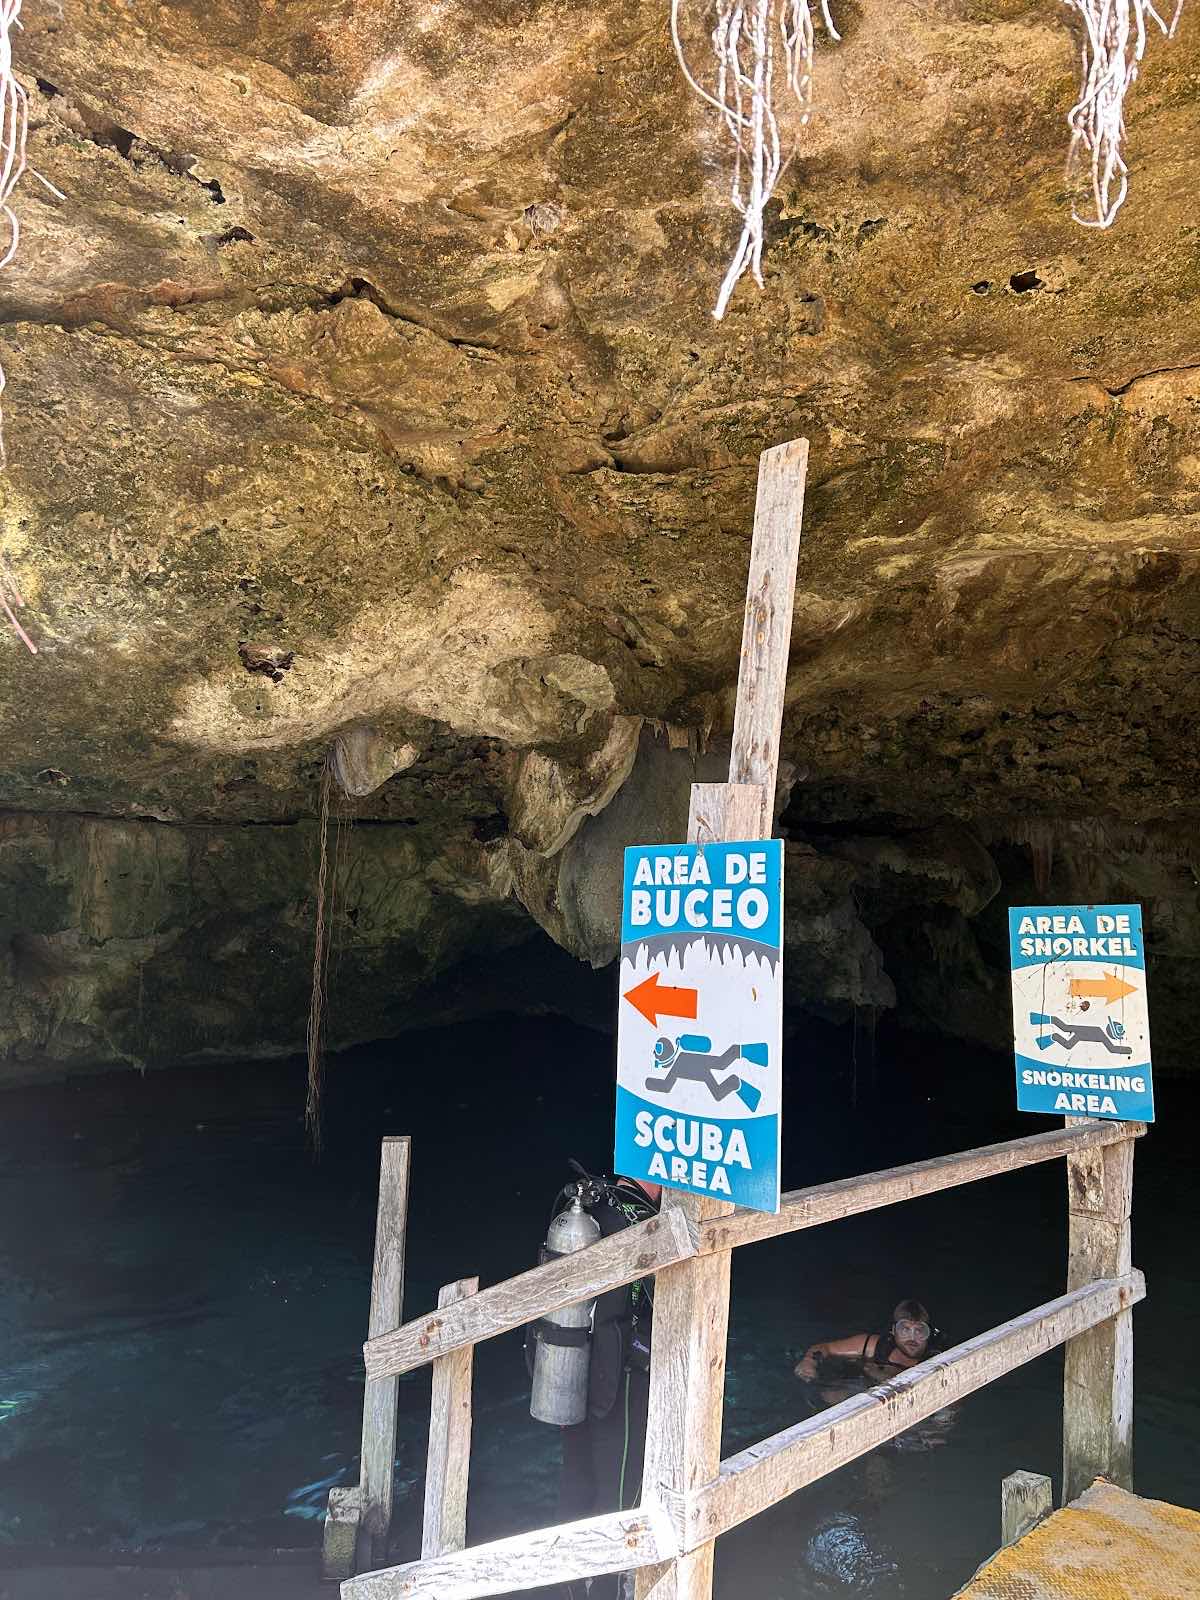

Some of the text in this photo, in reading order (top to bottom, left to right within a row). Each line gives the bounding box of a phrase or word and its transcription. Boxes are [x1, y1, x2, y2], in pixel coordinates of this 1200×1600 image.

[633, 852, 767, 886] AREA DE
[631, 888, 769, 929] BUCEO
[1018, 915, 1131, 934] AREA DE
[1020, 938, 1137, 956] SNORKEL
[1022, 1070, 1146, 1092] SNORKELING
[1055, 1093, 1118, 1114] AREA
[633, 1110, 752, 1170] SCUBA
[648, 1152, 732, 1195] AREA
